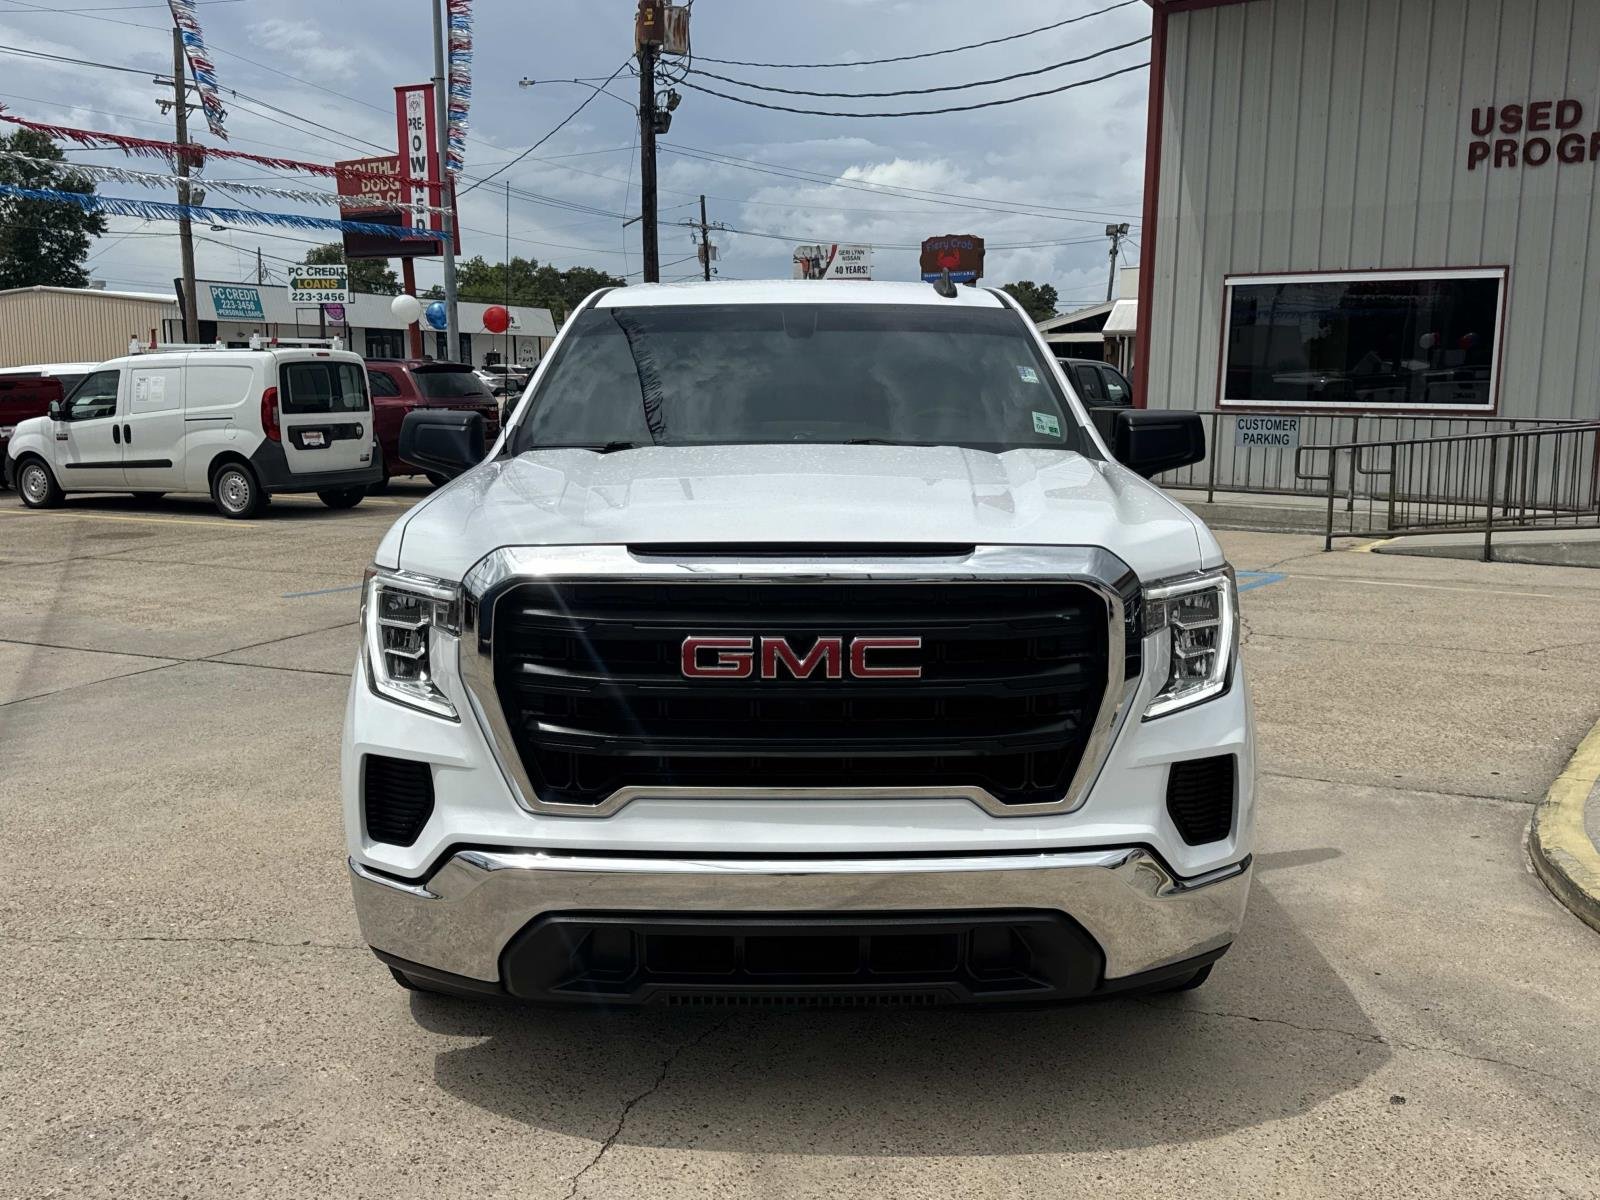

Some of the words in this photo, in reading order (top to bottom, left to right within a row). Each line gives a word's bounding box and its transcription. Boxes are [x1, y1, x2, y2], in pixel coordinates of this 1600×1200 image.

[1471, 100, 1583, 136] USED
[951, 239, 973, 250] Crab
[288, 266, 303, 277] PC
[306, 266, 346, 277] CREDIT
[835, 265, 844, 274] 40
[845, 265, 868, 274] YEARS!
[297, 278, 338, 289] LOANS
[211, 287, 225, 299] PC
[225, 288, 258, 301] CREDIT
[292, 292, 345, 302] 223-3456
[221, 299, 256, 310] 223-3456
[1238, 418, 1297, 431] CUSTOMER
[1243, 433, 1290, 445] PARKING
[681, 636, 922, 679] GMC
